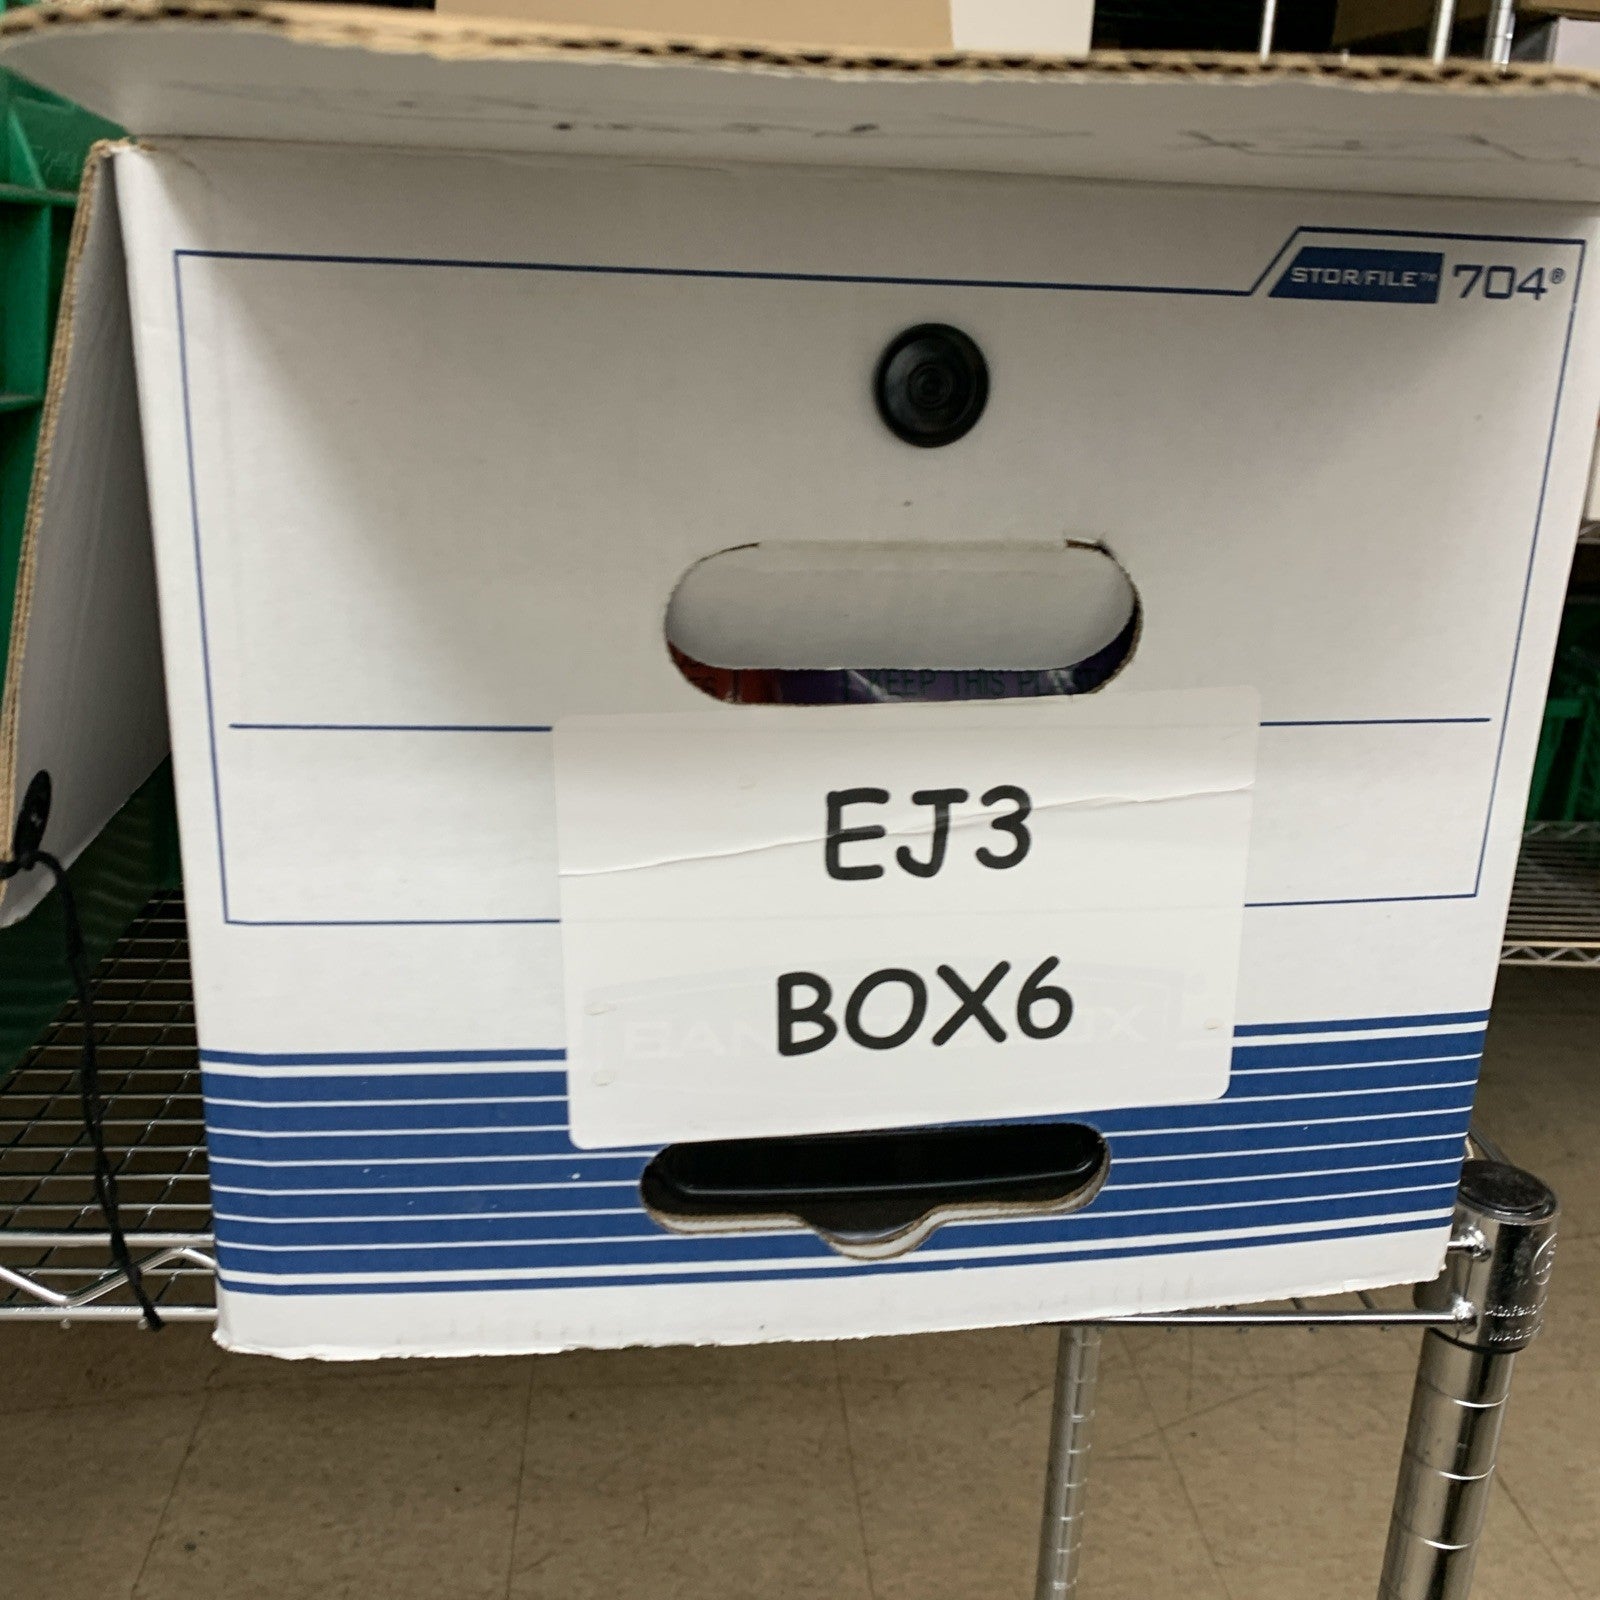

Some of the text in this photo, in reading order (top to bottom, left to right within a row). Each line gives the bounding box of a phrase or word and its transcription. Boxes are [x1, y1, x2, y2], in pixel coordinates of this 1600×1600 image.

[949, 669, 1006, 693] THIS
[825, 784, 1032, 881] EJ3
[778, 955, 1074, 1057] BOX6
